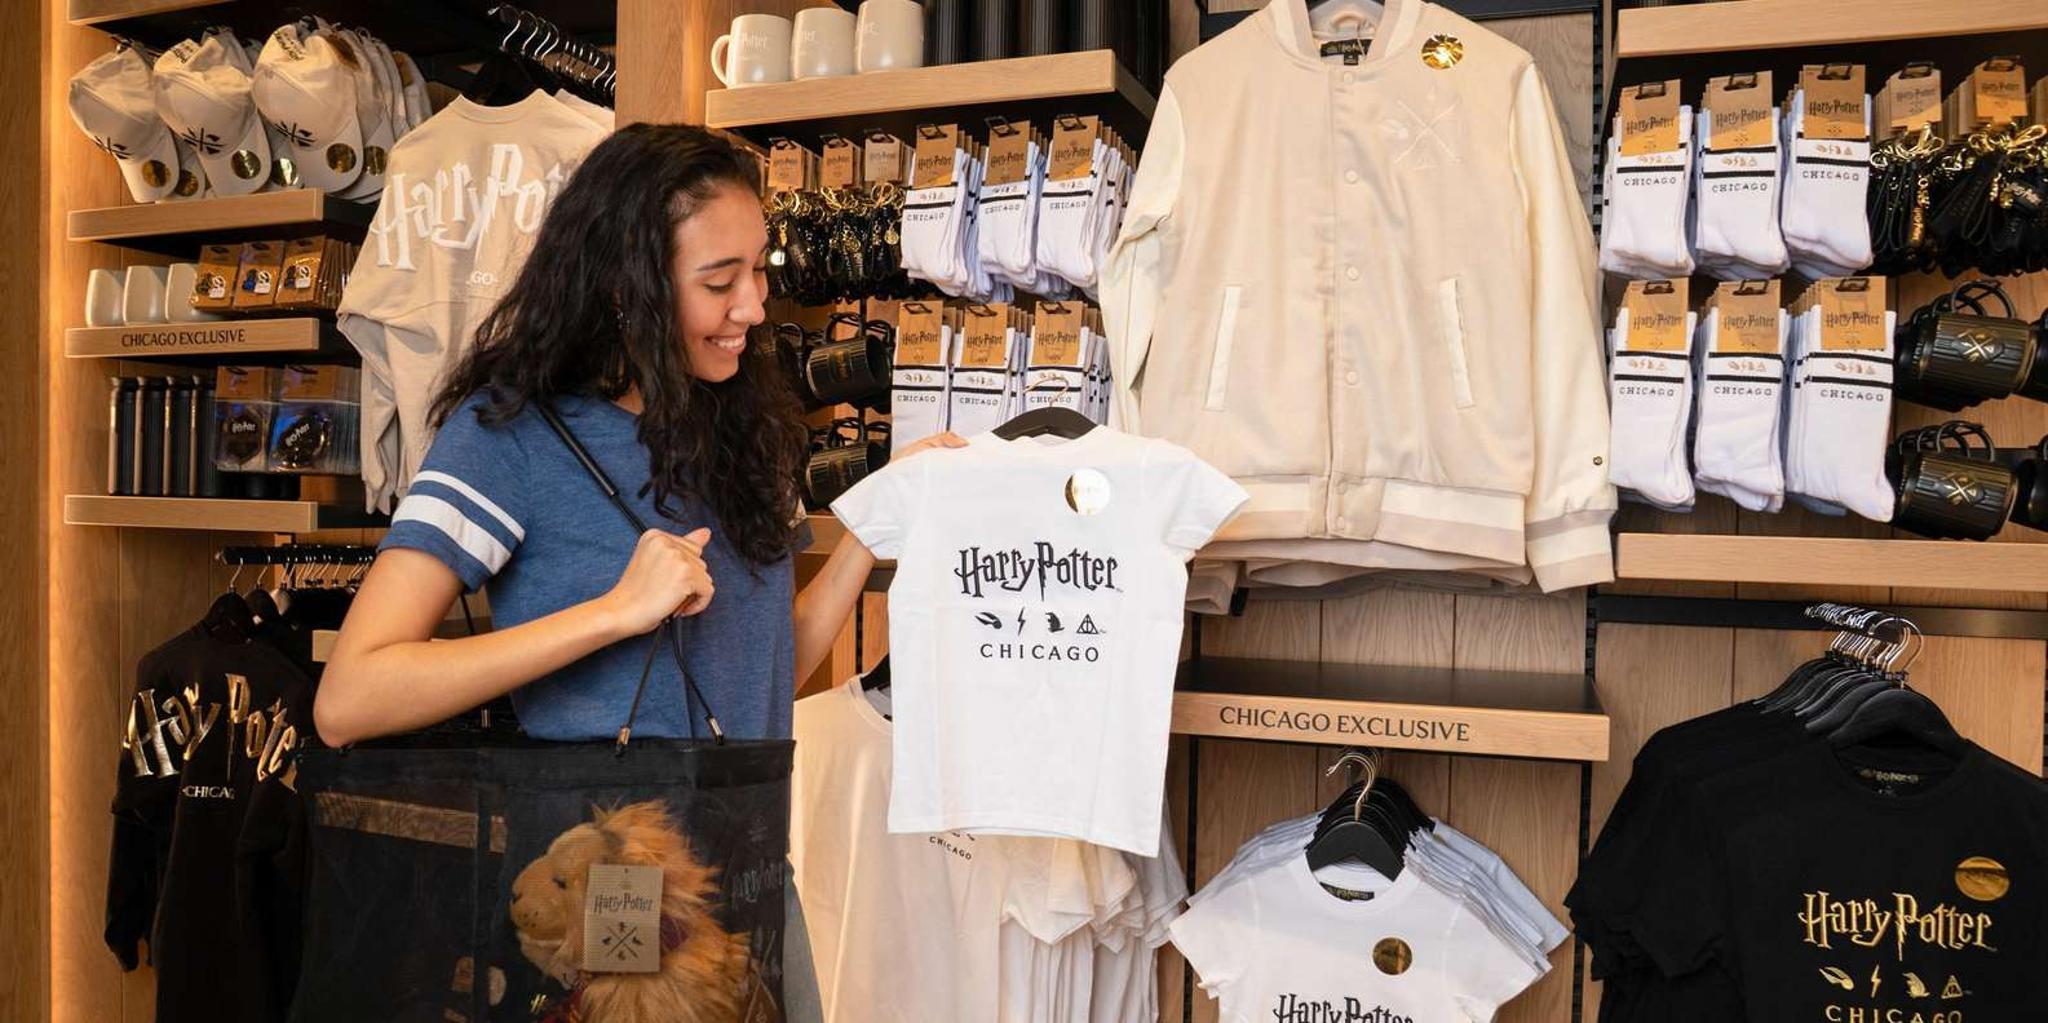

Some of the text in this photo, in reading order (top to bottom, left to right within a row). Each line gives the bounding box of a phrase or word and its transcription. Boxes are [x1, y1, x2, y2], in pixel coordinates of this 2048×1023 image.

[1809, 100, 1860, 115] Harry Potter
[1716, 108, 1767, 128] Harry Potter
[1623, 176, 1677, 186] CHICAGO
[1802, 170, 1860, 181] CHICAGO
[1711, 182, 1768, 193] CHICAGO
[984, 204, 1020, 214] CHICAGO
[1049, 201, 1087, 210] CHICAGO
[370, 162, 492, 271] Harry
[1724, 314, 1774, 331] Harry Potter
[1825, 312, 1880, 328] Harry Potter
[122, 329, 246, 347] CHICAGO EXCLUSIVE
[897, 395, 937, 403] CHICAGO
[1619, 386, 1675, 397] CHICAGO
[1713, 386, 1773, 396] CHICAGO
[1820, 389, 1884, 401] CHICAGO
[959, 397, 999, 406] CHICAGO
[954, 542, 1119, 601] Harry Potter
[980, 643, 1099, 662] CHICAGO
[1219, 705, 1470, 742] CHICAGO EXCLUSIVE
[929, 836, 972, 860] CHICAGO
[1797, 891, 1993, 961] Harry Potter
[1343, 997, 1414, 1023] Pott
[1825, 1005, 1962, 1023] CHICAGO
